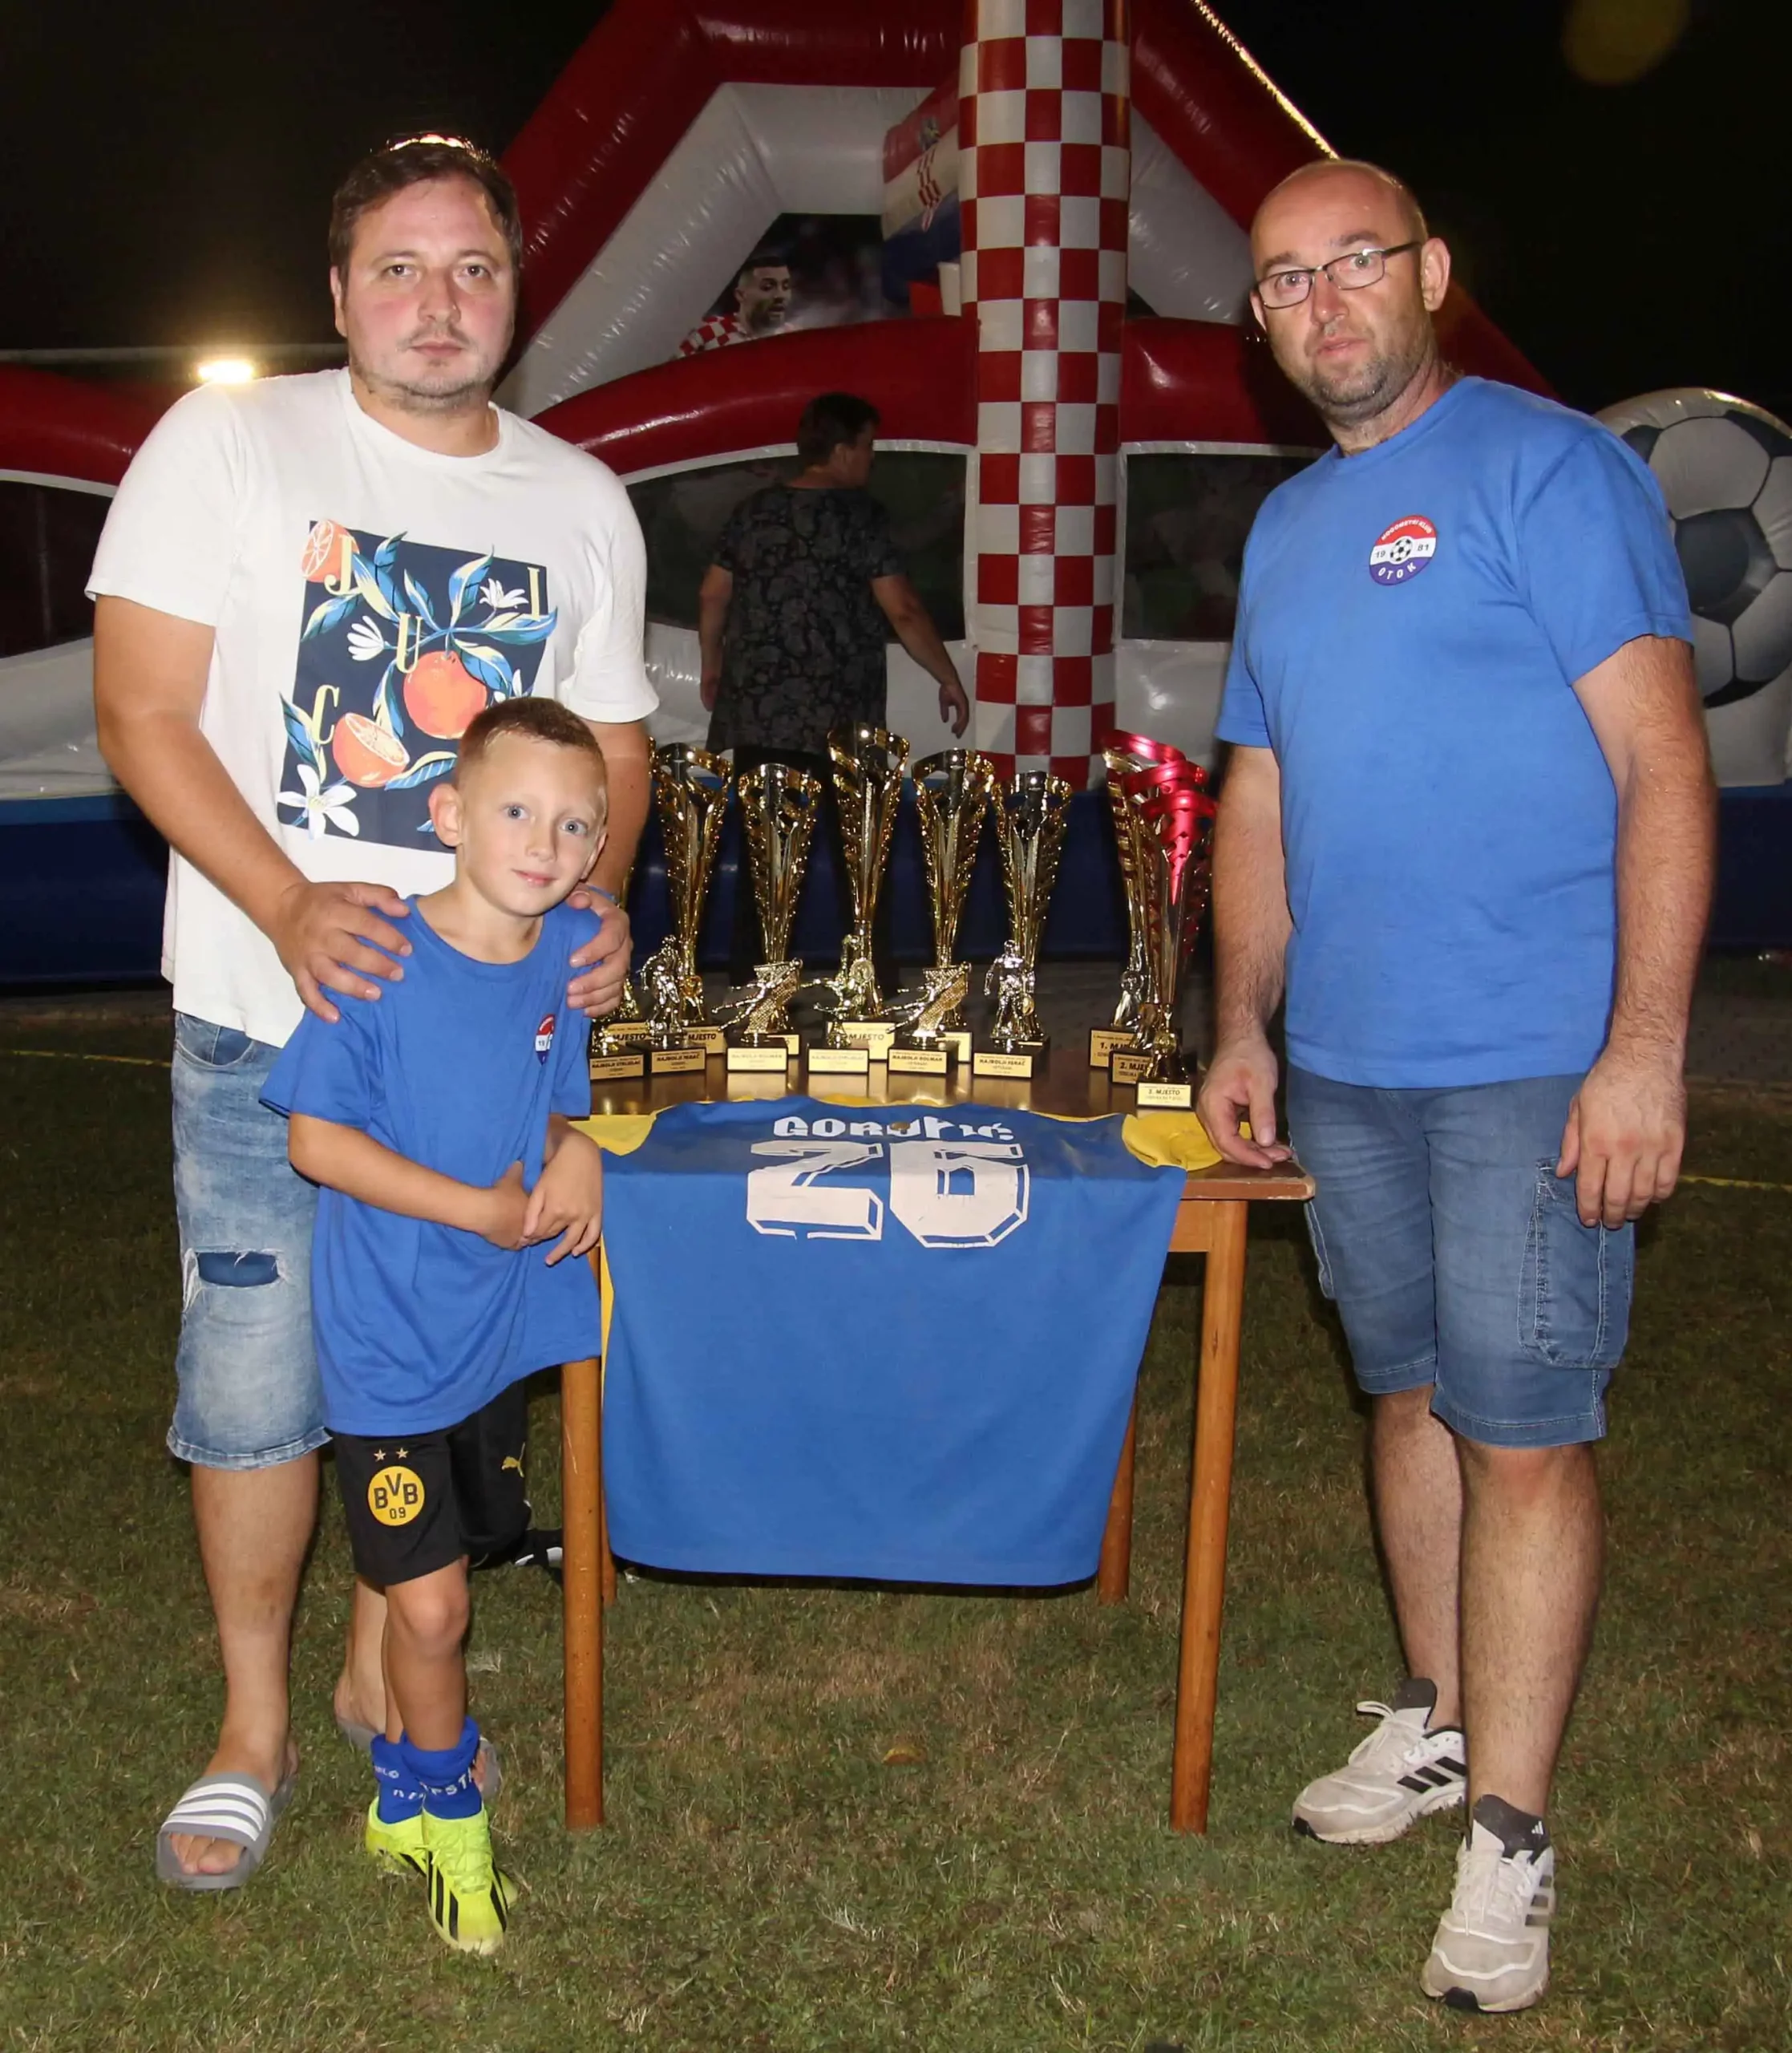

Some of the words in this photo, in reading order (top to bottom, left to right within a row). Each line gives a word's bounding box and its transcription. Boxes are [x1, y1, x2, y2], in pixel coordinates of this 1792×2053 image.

[1378, 562, 1417, 580] OTOK
[746, 1140, 1029, 1249] 26
[374, 1473, 418, 1509] BVB
[389, 1507, 407, 1520] 09
